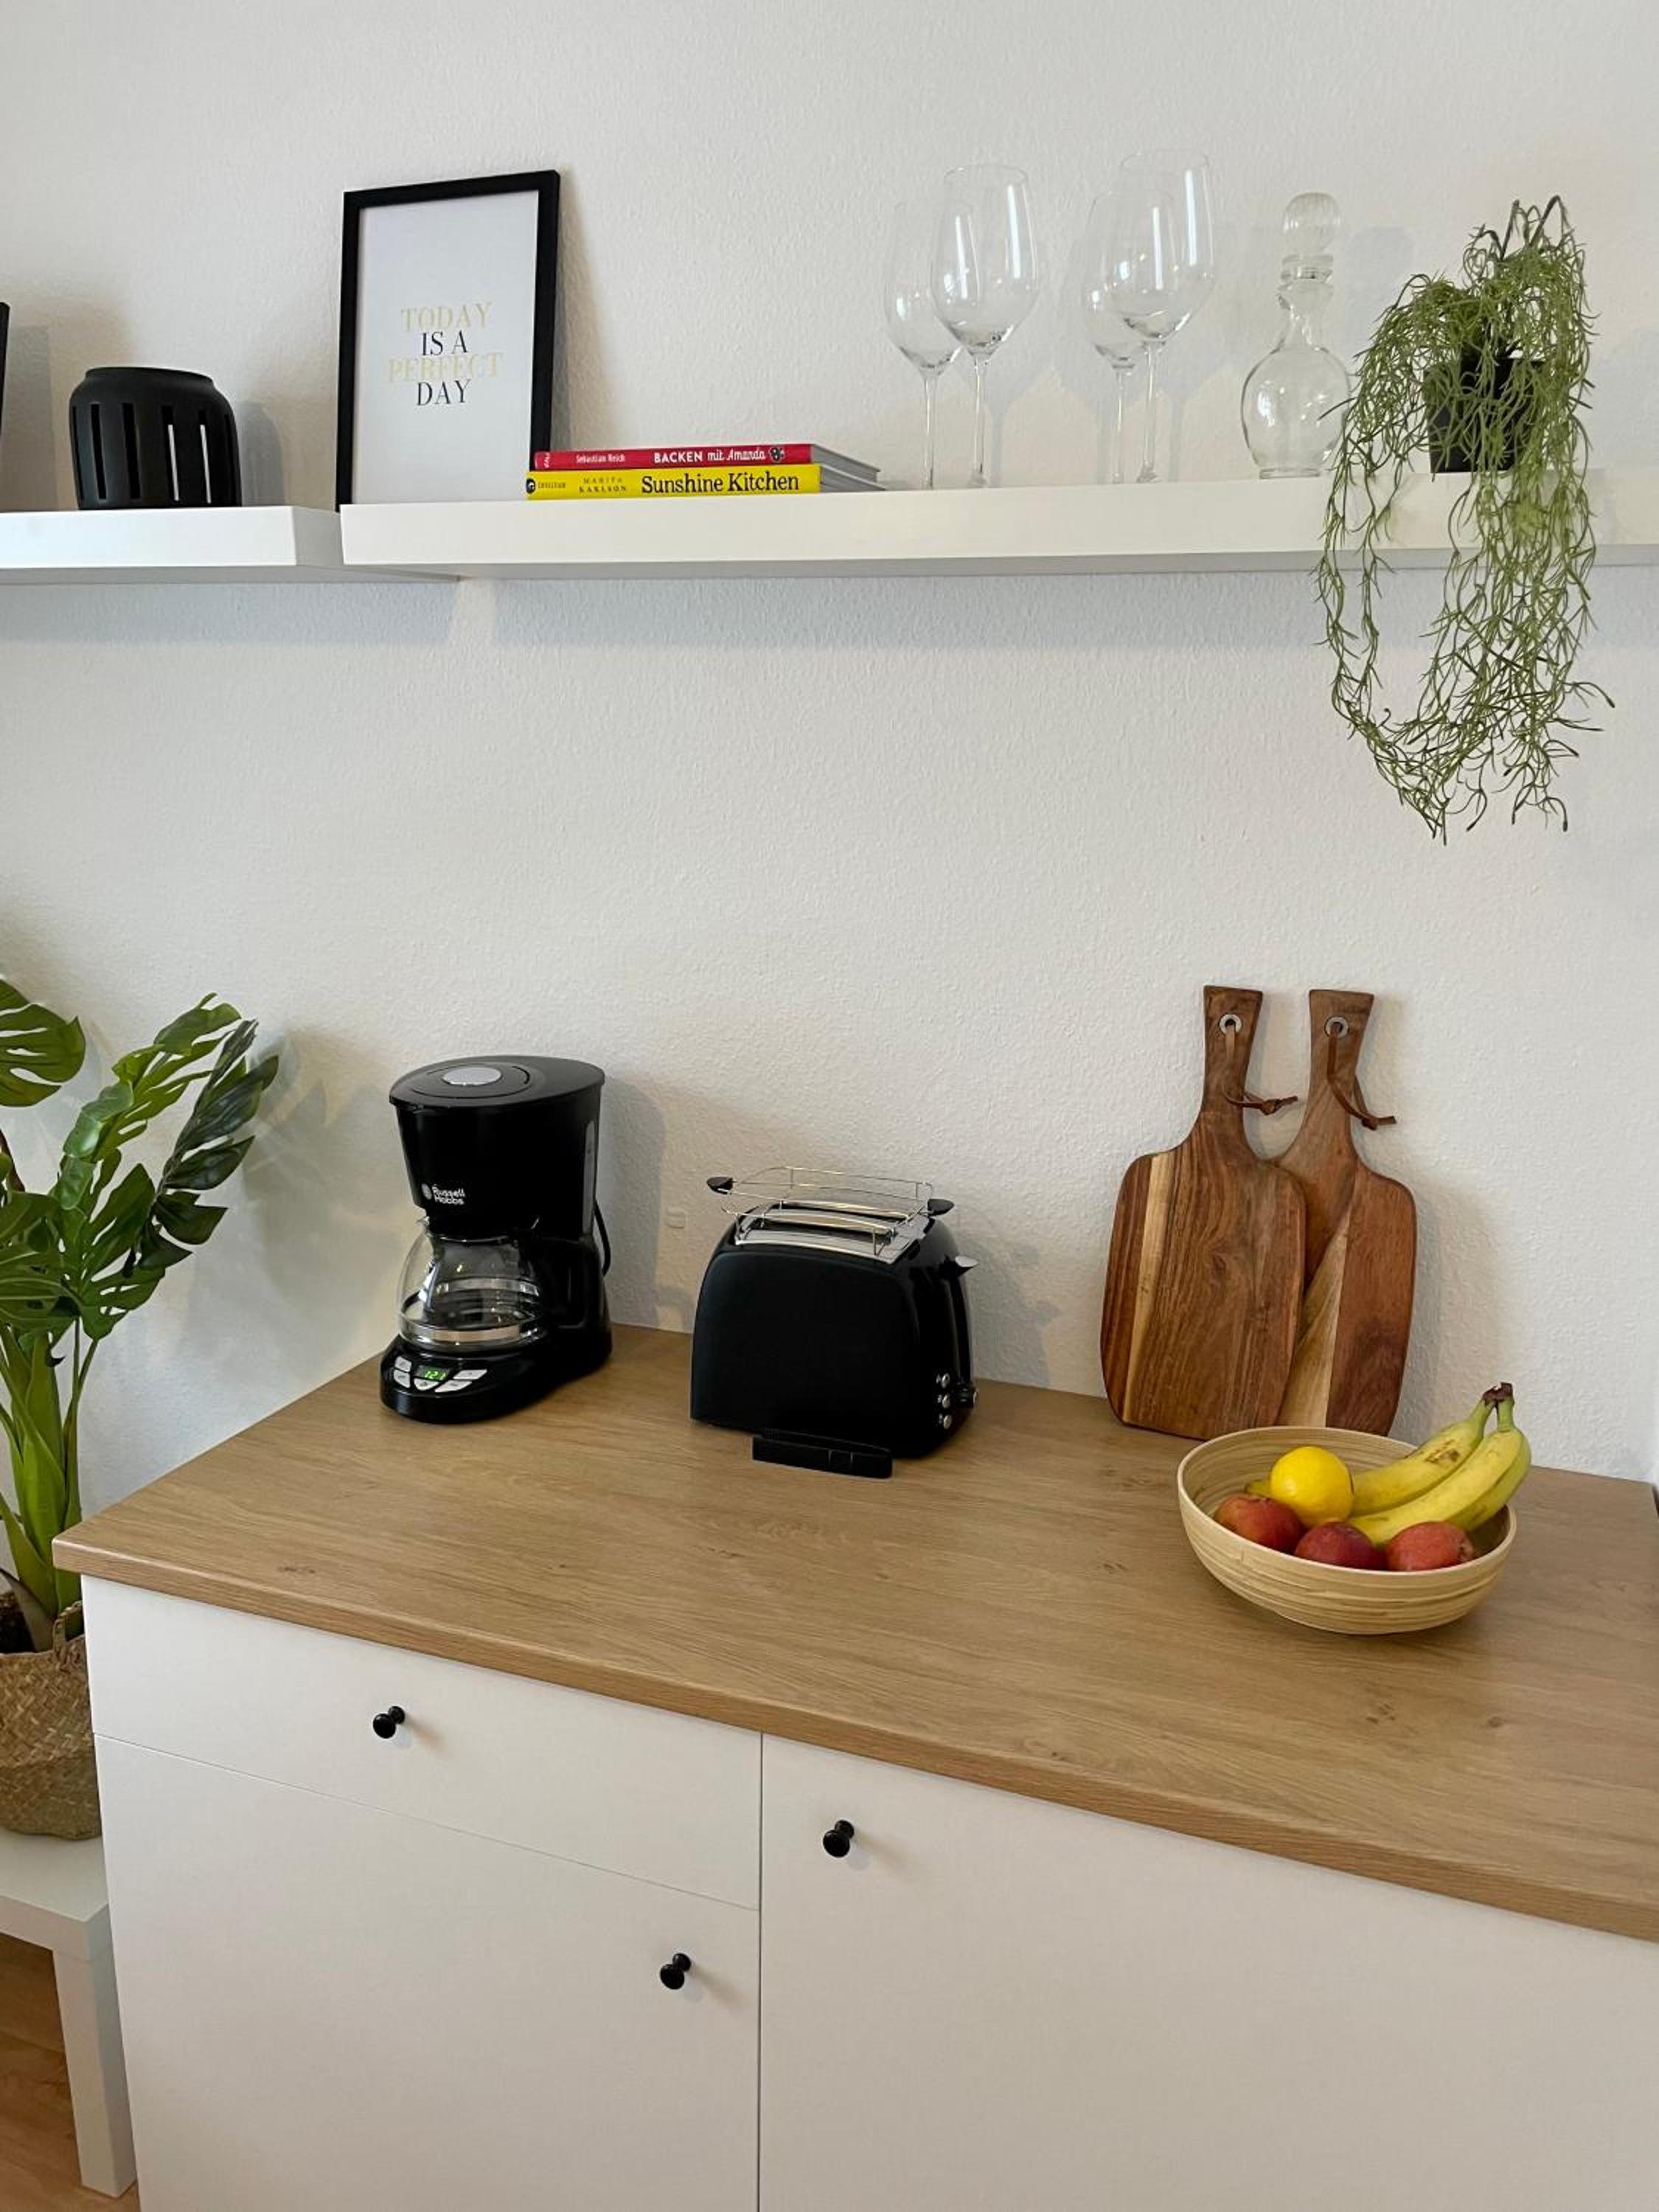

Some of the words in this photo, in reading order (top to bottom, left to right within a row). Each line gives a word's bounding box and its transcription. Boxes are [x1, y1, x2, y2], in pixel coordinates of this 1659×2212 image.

[401, 302, 493, 330] TODAY
[422, 331, 443, 355] IS
[452, 330, 468, 354] A
[389, 352, 504, 383] PERFECT
[417, 379, 471, 406] DAY
[654, 451, 703, 464] BACKEN
[707, 449, 724, 461] mit
[726, 447, 766, 461] Amanda
[641, 473, 723, 494] Sunshine
[728, 470, 799, 492] Kitchen
[432, 1184, 465, 1197] Russell
[434, 1195, 465, 1205] Hobbs
